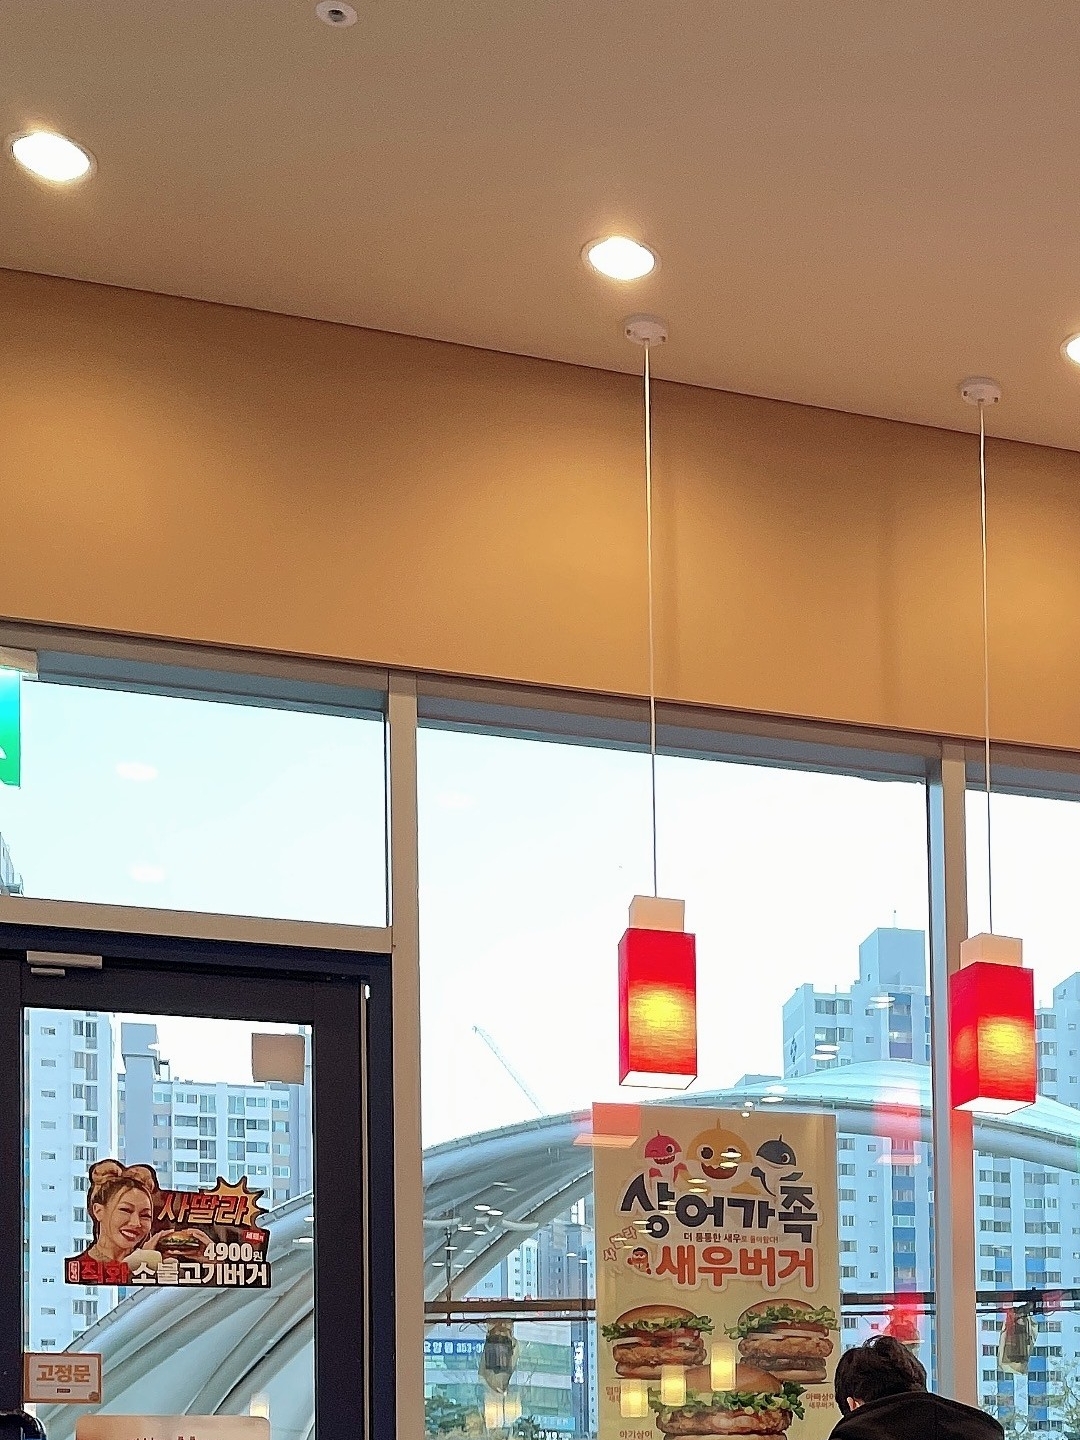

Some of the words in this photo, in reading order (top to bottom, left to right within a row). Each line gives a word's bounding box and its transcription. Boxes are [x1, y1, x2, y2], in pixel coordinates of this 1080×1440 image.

[157, 1194, 249, 1226] 사딸라
[620, 1173, 818, 1243] 상어가족
[683, 1232, 692, 1242] 더
[203, 1242, 264, 1262] 4900원
[81, 1260, 128, 1284] 직화
[132, 1262, 268, 1286] 소불고기버거
[656, 1245, 814, 1288] 새우버거
[36, 1364, 91, 1383] 고정문
